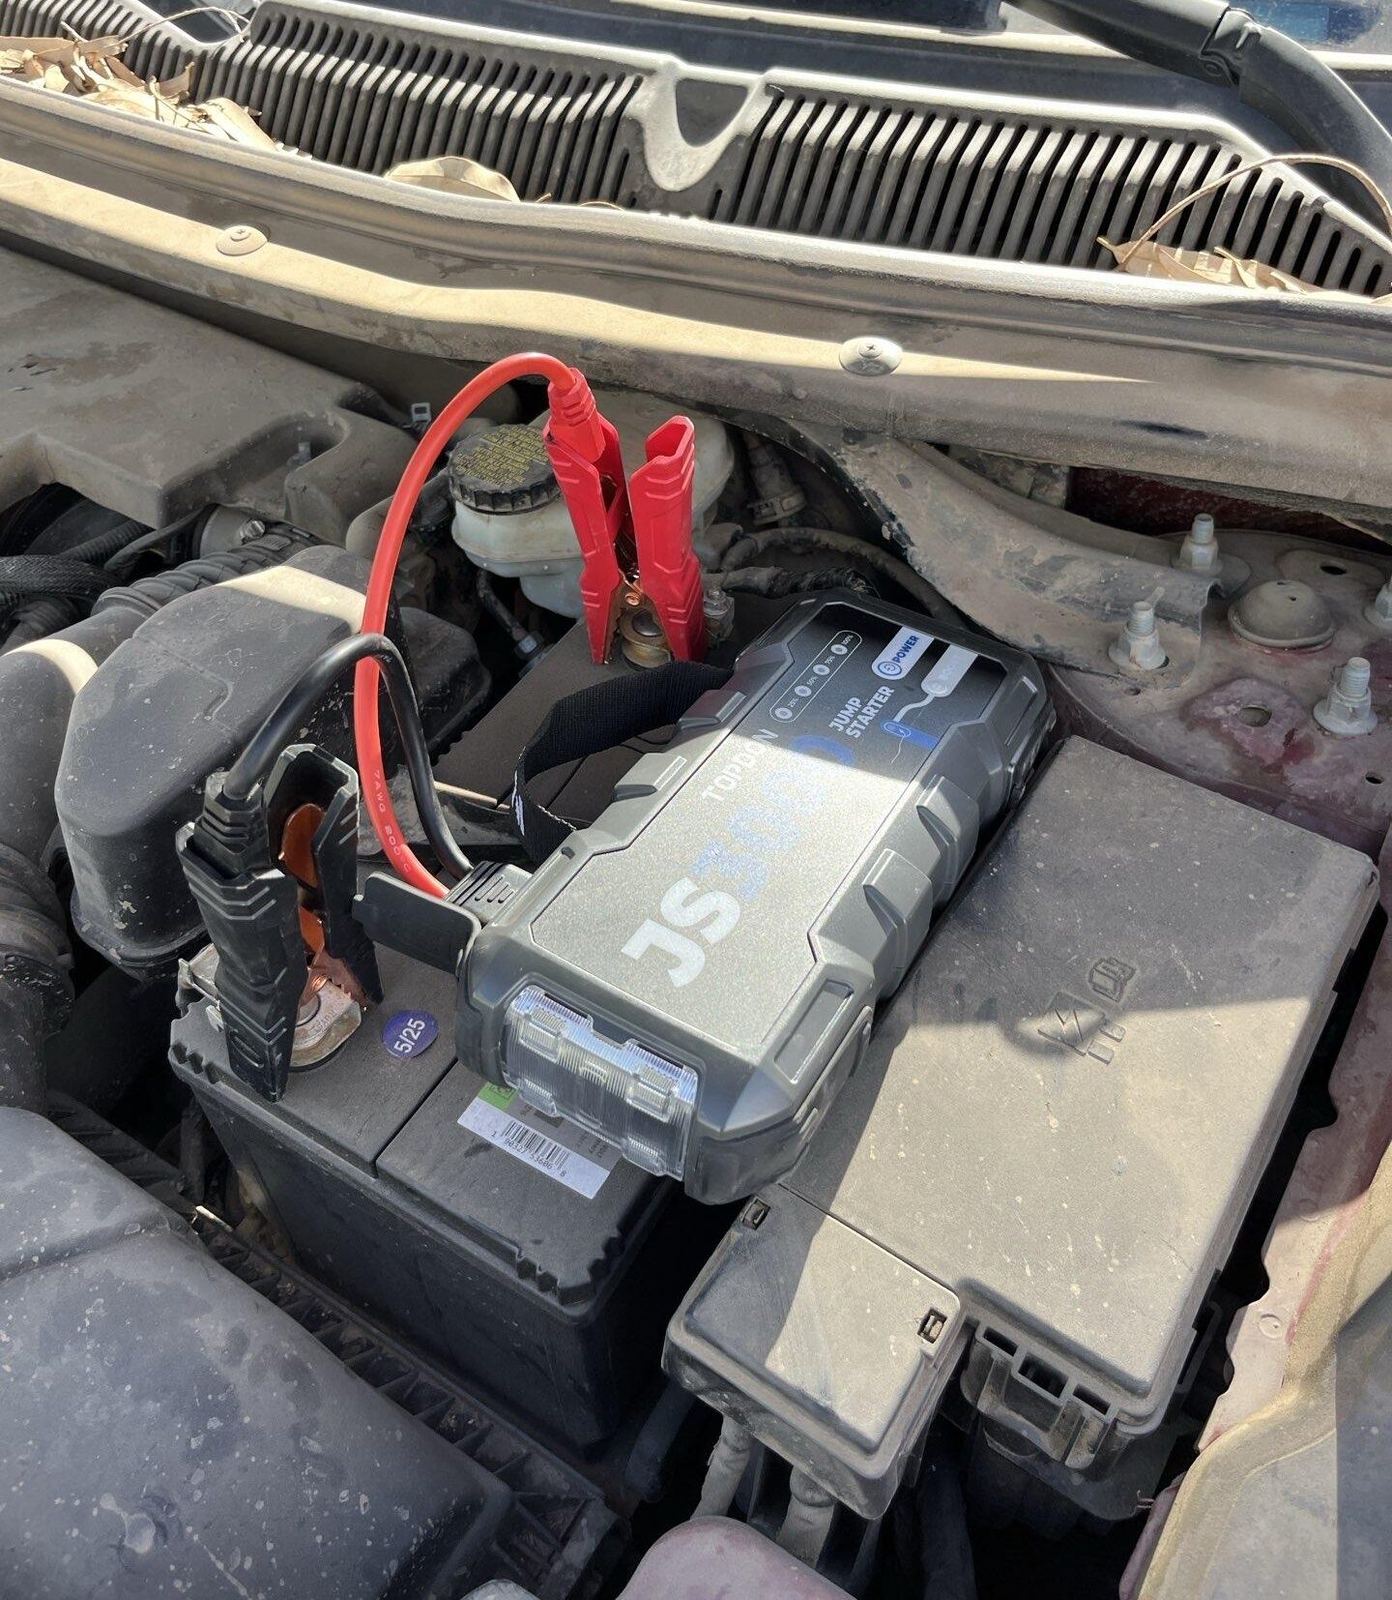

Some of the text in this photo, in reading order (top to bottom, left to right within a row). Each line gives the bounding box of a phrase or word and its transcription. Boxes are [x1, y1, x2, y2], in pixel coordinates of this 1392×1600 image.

[892, 635, 920, 664] POWER
[829, 696, 862, 732] JUMP
[846, 685, 895, 739] STARTER
[393, 1018, 426, 1054] 5/25
